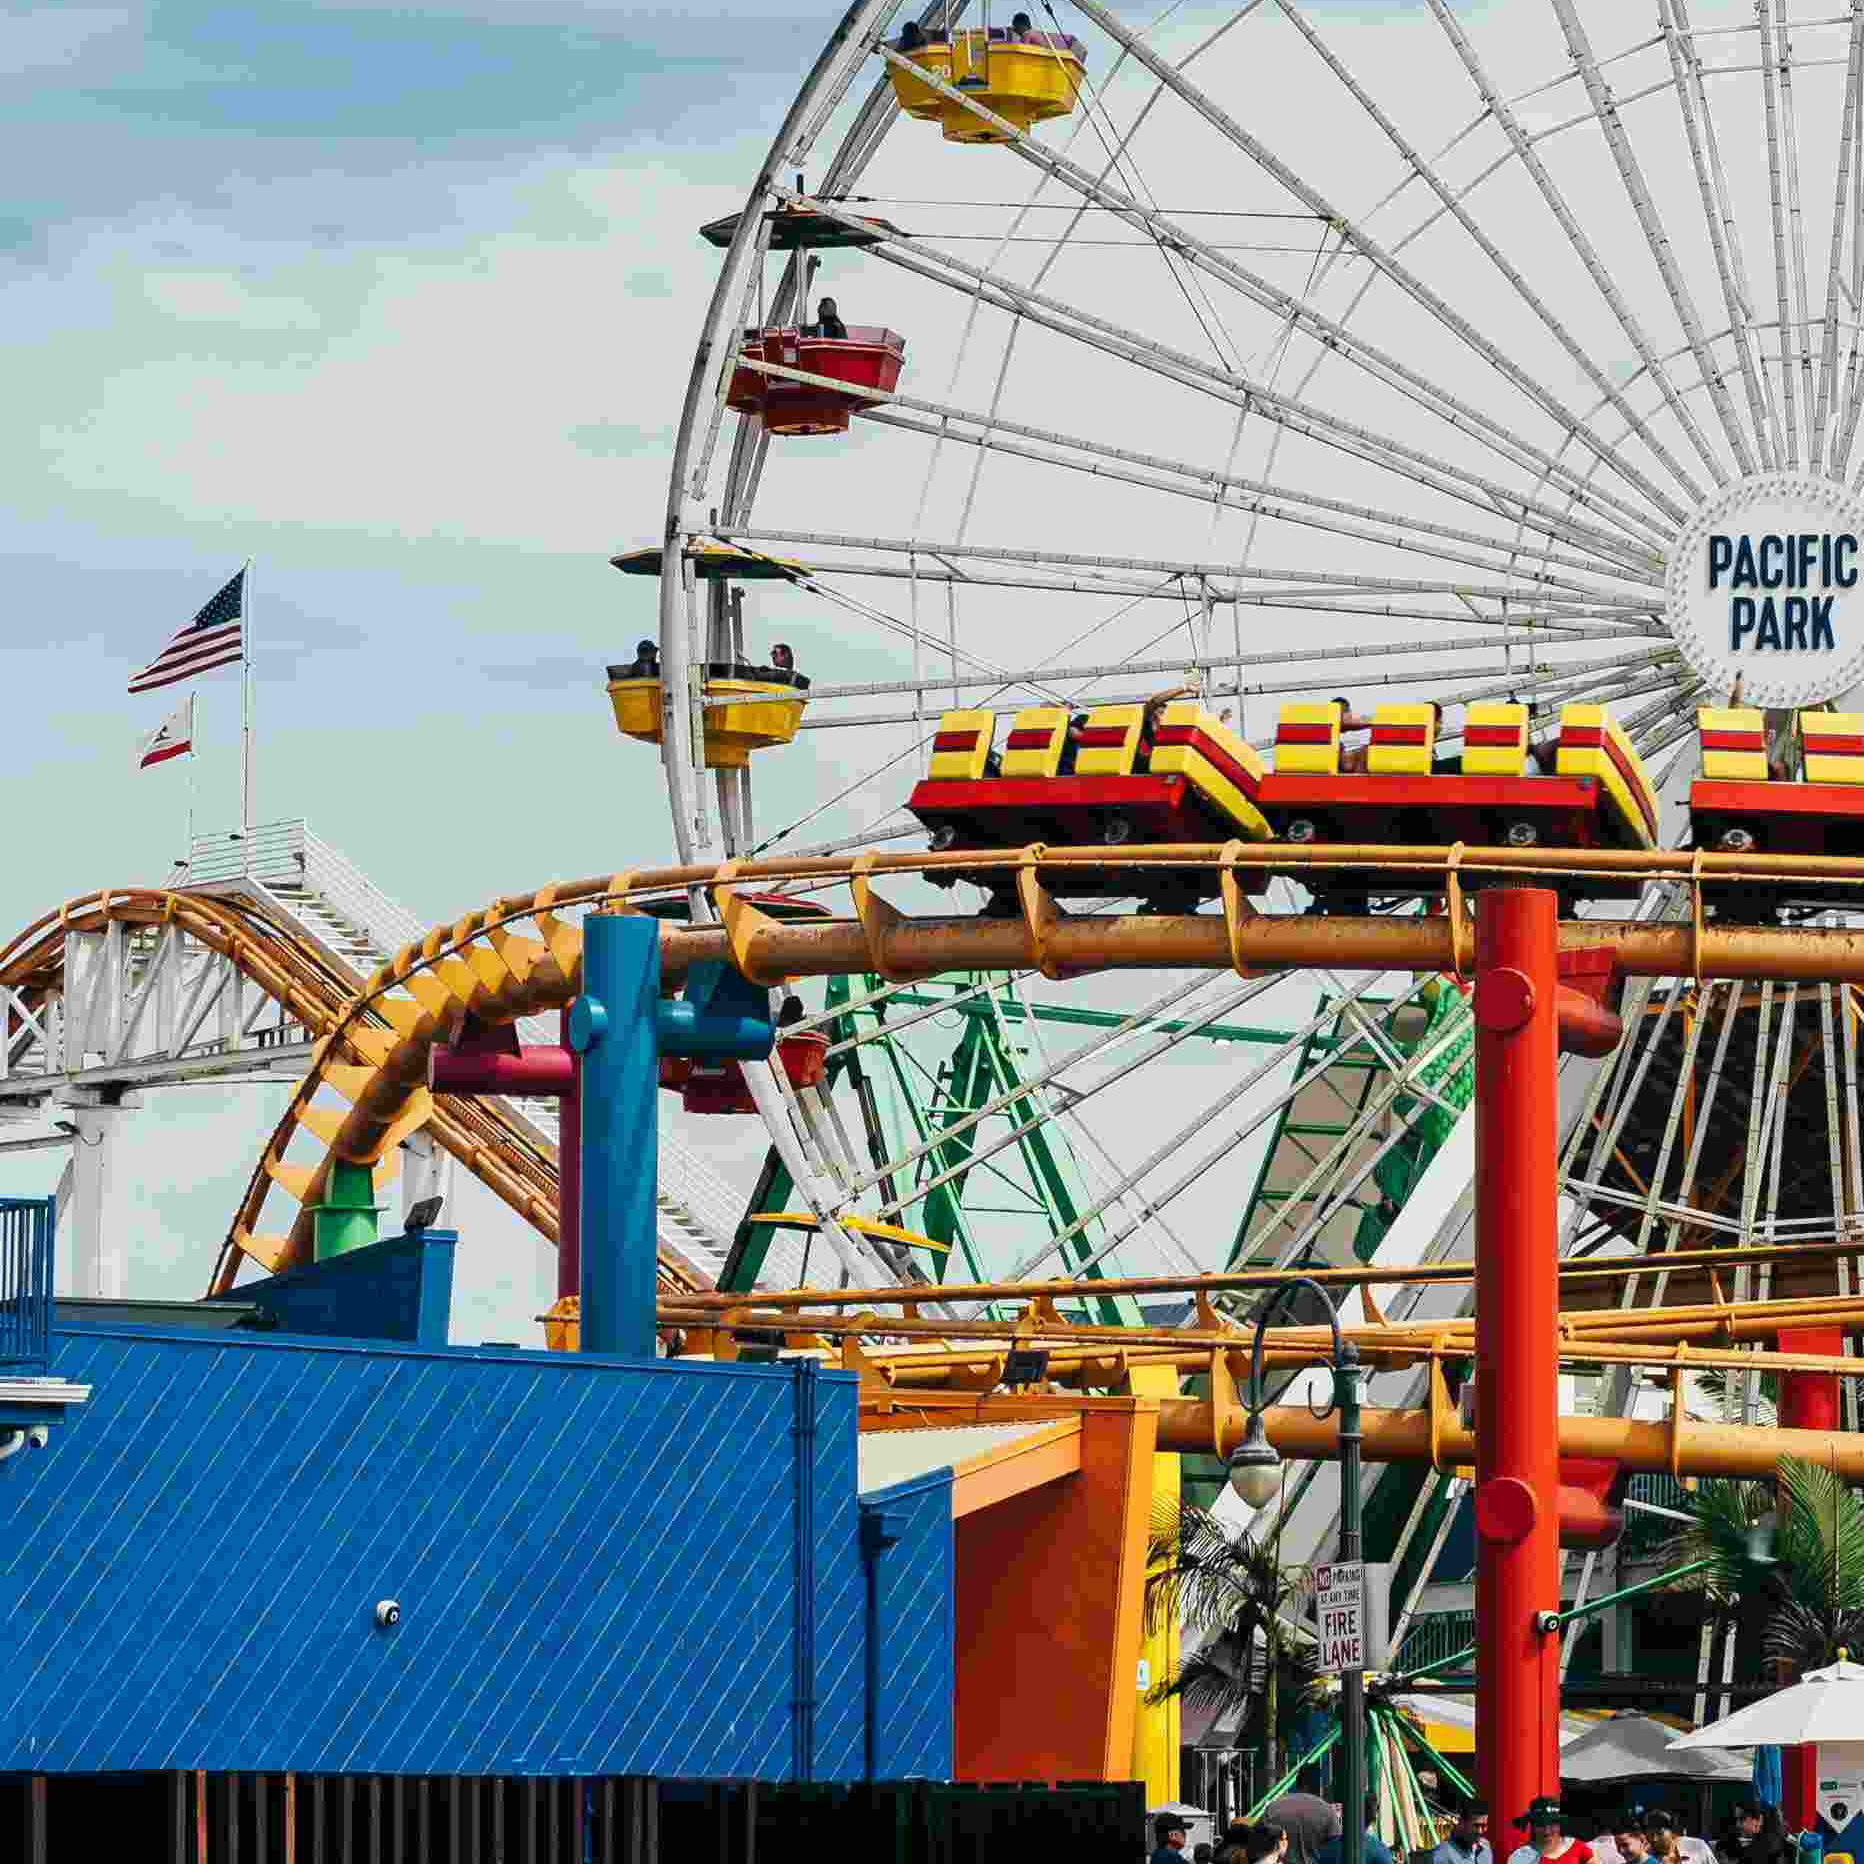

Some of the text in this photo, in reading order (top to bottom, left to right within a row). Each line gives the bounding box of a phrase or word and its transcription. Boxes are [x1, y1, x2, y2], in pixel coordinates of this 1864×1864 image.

[1709, 534, 1858, 589] PACIFIC
[1731, 596, 1836, 650] PARK
[1325, 1610, 1357, 1637] FIRE
[1322, 1638, 1360, 1666] LANE
